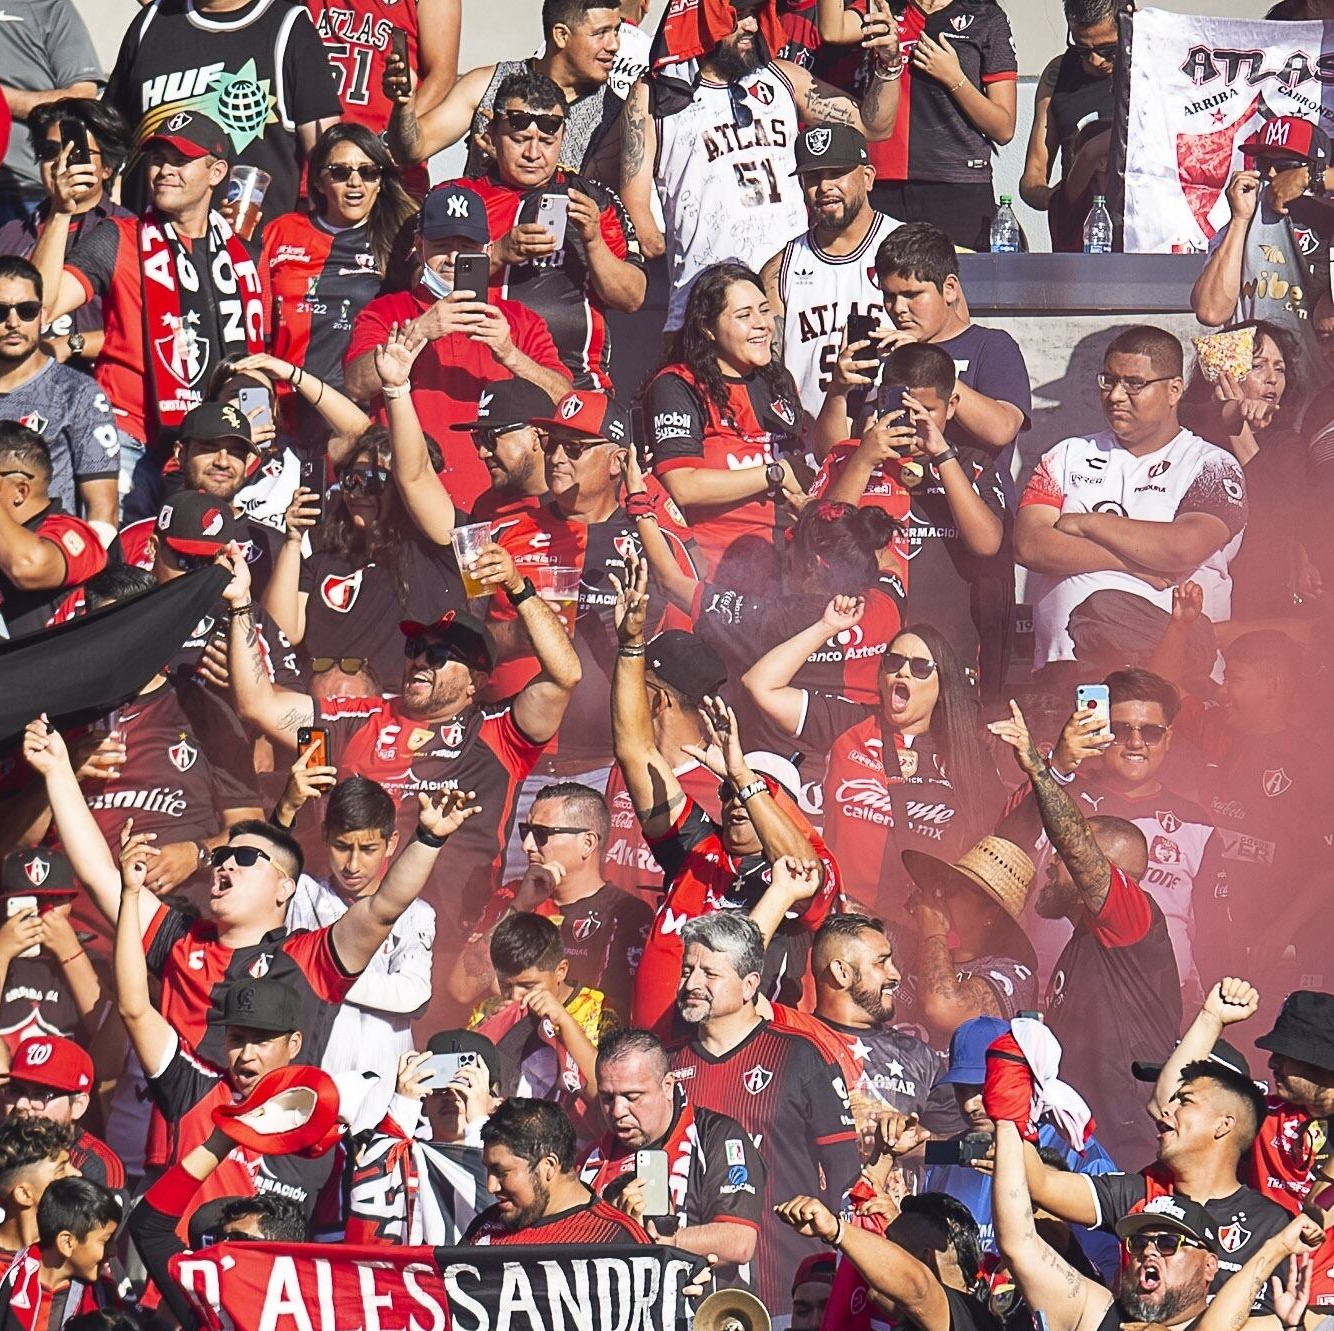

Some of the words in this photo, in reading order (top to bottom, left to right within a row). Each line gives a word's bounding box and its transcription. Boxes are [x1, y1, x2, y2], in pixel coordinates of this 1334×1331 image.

[313, 7, 393, 55] ATLAS
[141, 62, 226, 115] HUF
[1181, 88, 1240, 120] ARRIBA
[701, 116, 790, 163] ATLAS
[653, 410, 692, 429] Mobil
[807, 649, 843, 664] anco
[844, 643, 886, 660] Azteca
[605, 838, 665, 875] AKRO
